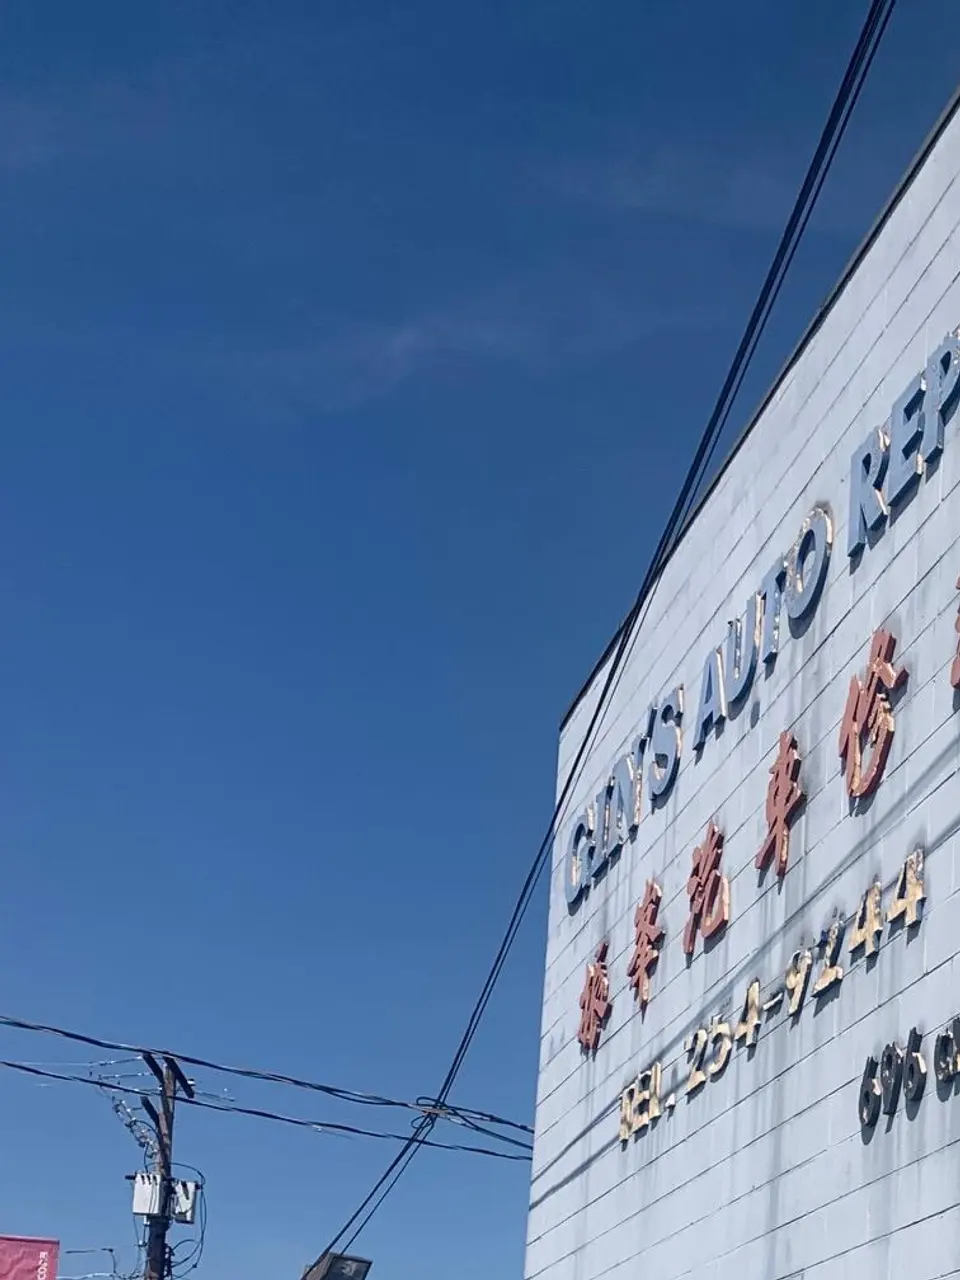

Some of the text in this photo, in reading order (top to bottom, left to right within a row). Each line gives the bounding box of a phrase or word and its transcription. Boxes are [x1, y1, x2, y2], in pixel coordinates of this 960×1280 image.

[564, 683, 684, 912] GIN'S
[692, 505, 834, 752] AUTO
[858, 1026, 927, 1127] 696
